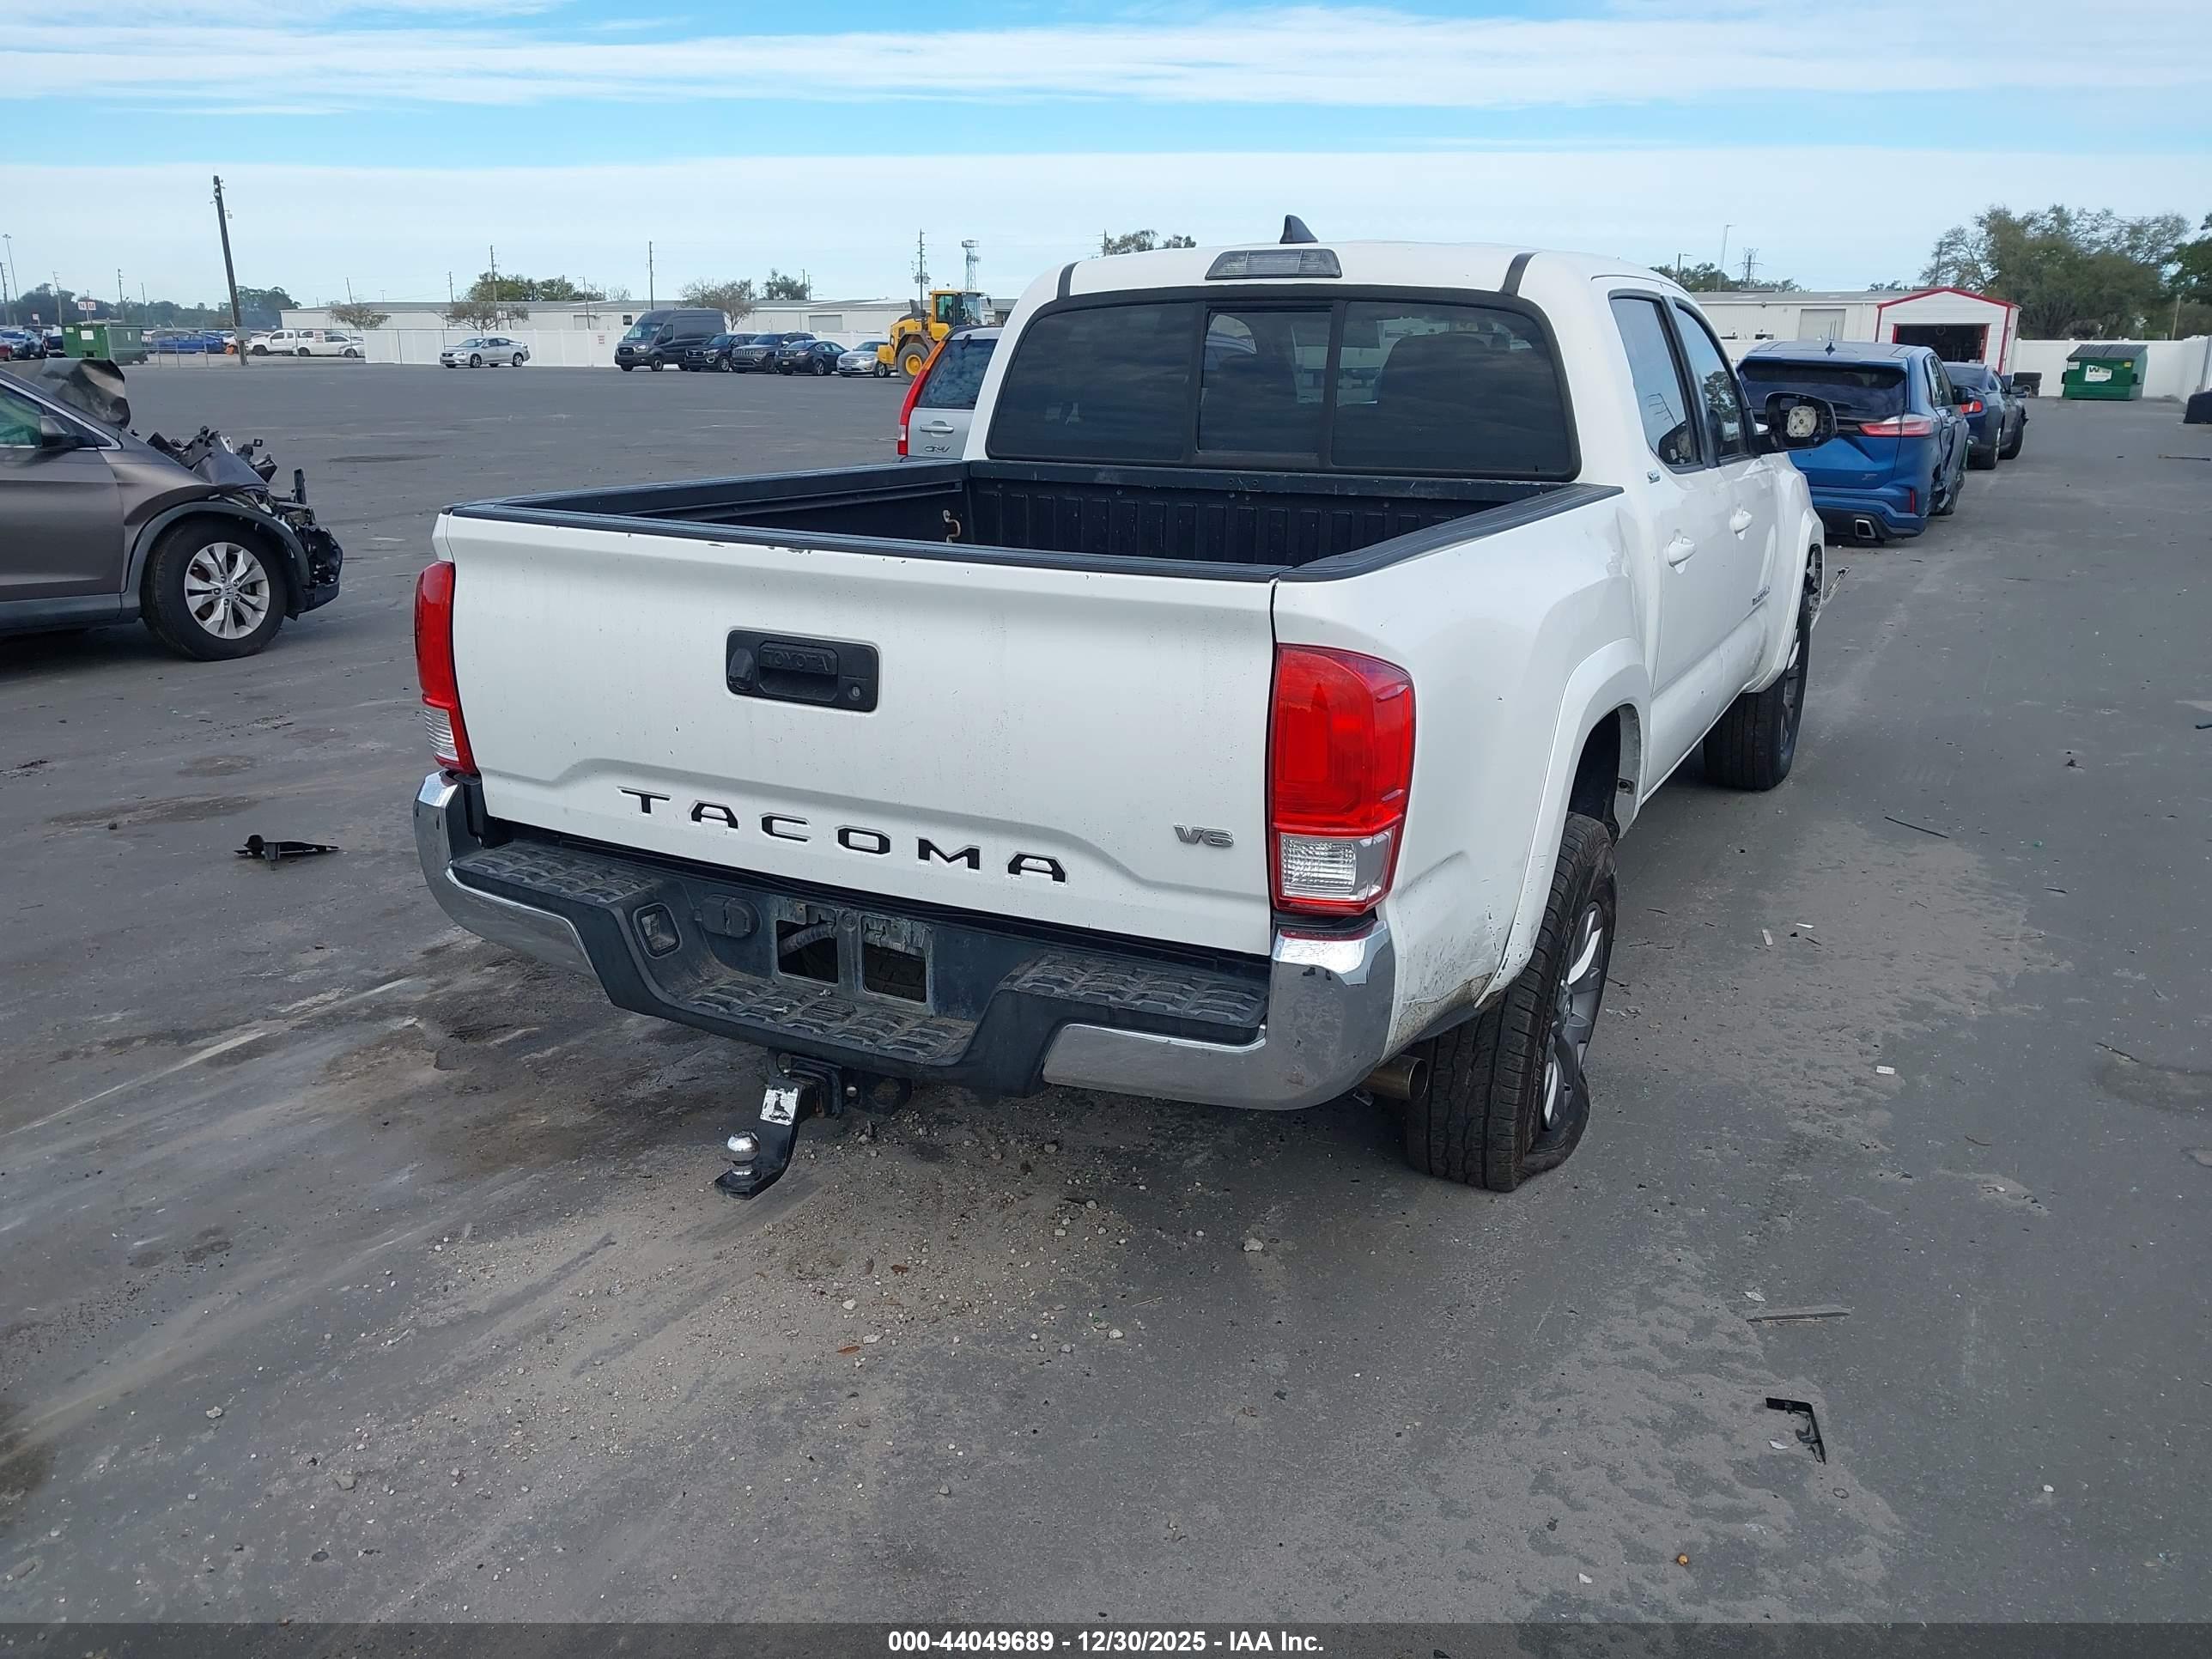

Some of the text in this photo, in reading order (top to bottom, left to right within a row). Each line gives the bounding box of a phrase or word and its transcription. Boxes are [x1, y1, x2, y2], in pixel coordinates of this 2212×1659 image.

[762, 648, 830, 672] TOYOTA
[617, 787, 1066, 884] TACOMA
[1173, 824, 1234, 847] V6
